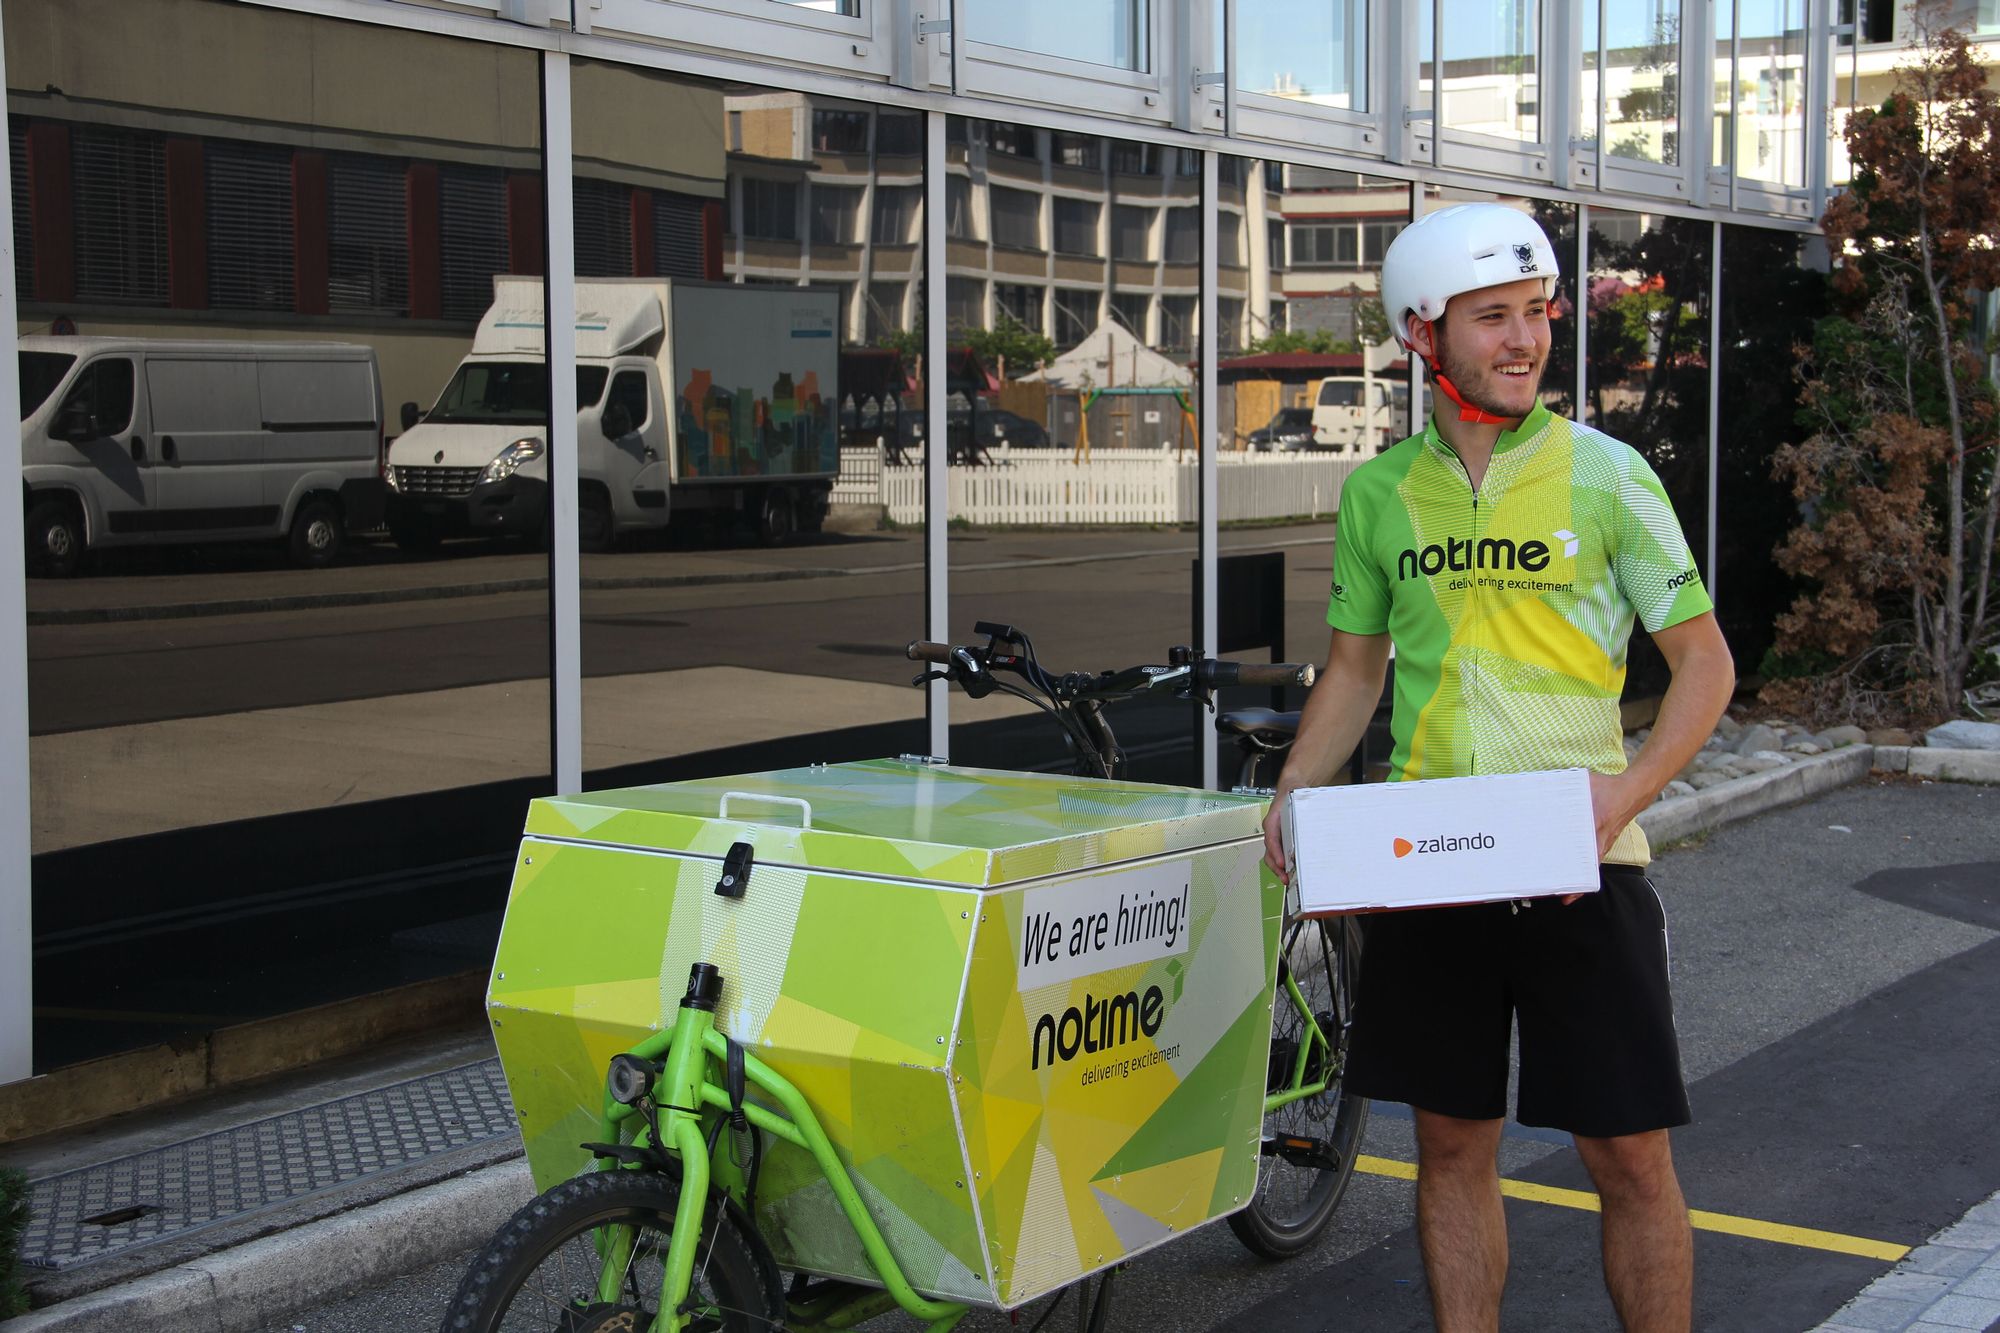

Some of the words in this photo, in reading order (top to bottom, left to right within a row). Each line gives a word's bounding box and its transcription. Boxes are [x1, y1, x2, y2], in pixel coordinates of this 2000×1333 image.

[1398, 536, 1550, 581] notime
[1449, 576, 1504, 591] delivering
[1507, 579, 1574, 593] excitement
[1417, 832, 1495, 853] zalando
[1024, 911, 1062, 967] We
[1068, 912, 1109, 957] are
[1114, 883, 1188, 948] hiring!
[1032, 985, 1164, 1071] notime
[1081, 1059, 1129, 1086] delivering
[1131, 1043, 1180, 1071] excitement
